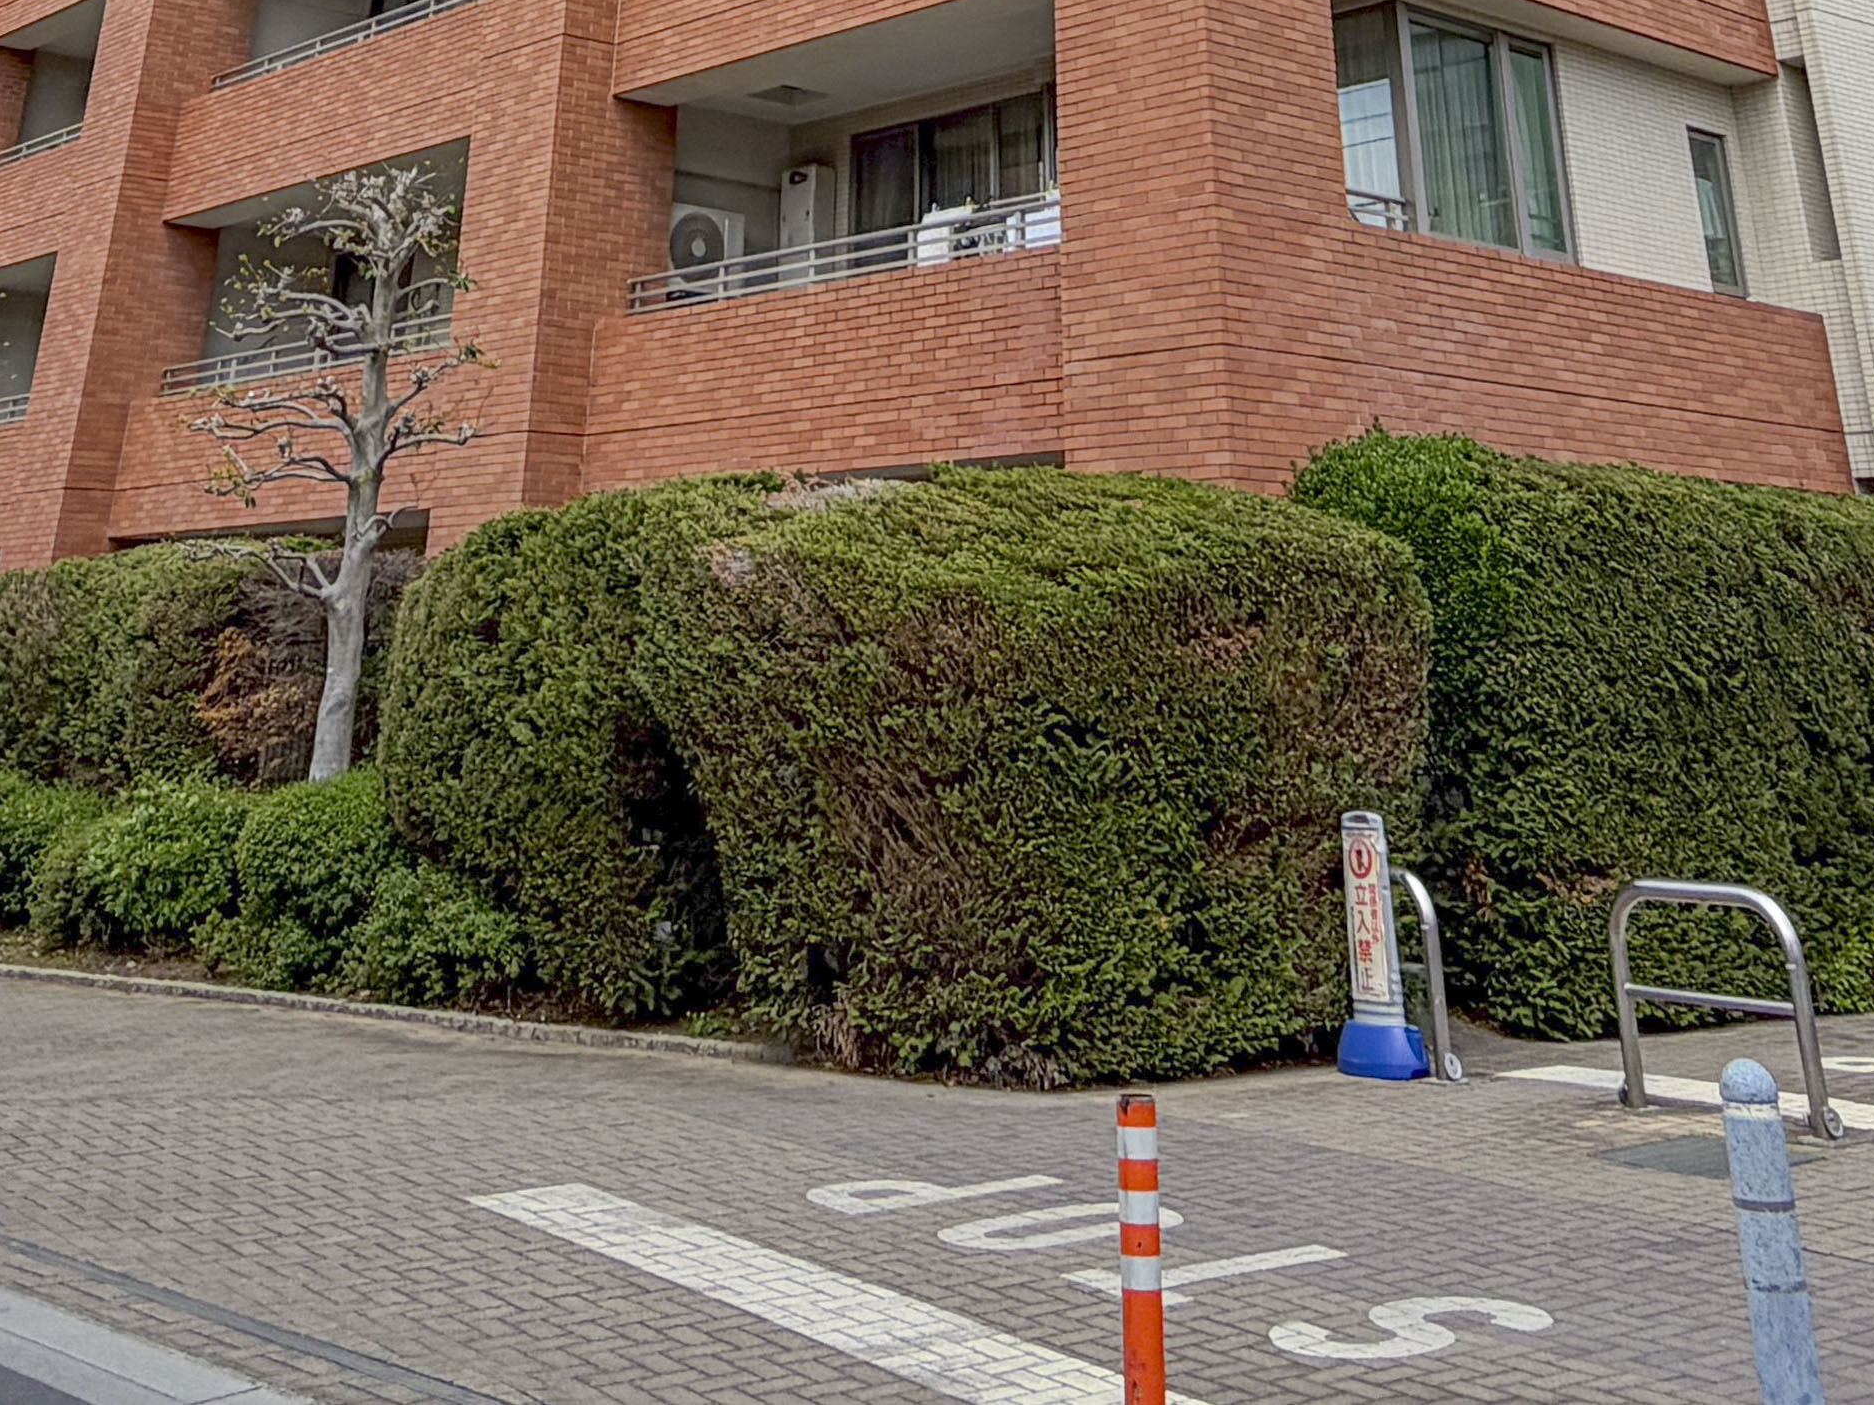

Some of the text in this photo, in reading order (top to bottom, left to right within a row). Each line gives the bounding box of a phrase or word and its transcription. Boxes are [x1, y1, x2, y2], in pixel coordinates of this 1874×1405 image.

[1354, 884, 1375, 991] 立入禁止
[805, 1174, 1554, 1359] STOP
